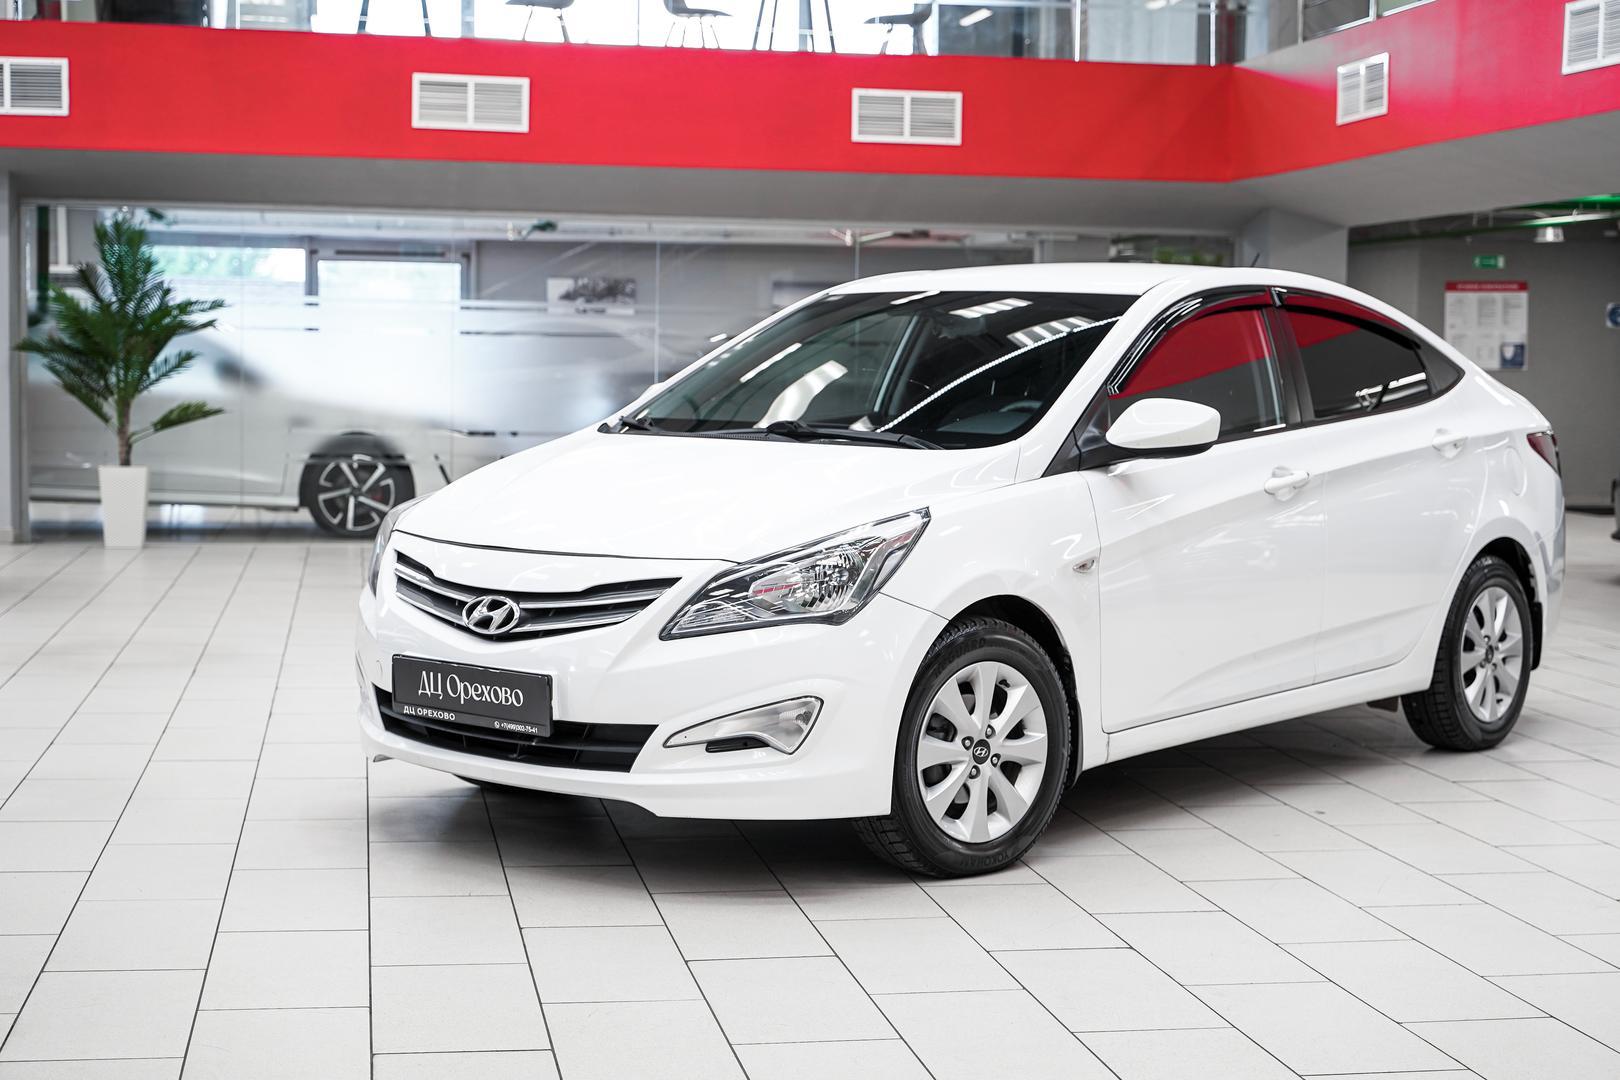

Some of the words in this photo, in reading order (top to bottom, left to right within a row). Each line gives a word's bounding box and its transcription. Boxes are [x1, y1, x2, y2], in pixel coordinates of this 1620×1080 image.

[418, 670, 443, 700] ДЦ
[446, 673, 524, 707] Орехово
[403, 705, 416, 716] ДЦ
[417, 707, 456, 720] ОРЕХОВО
